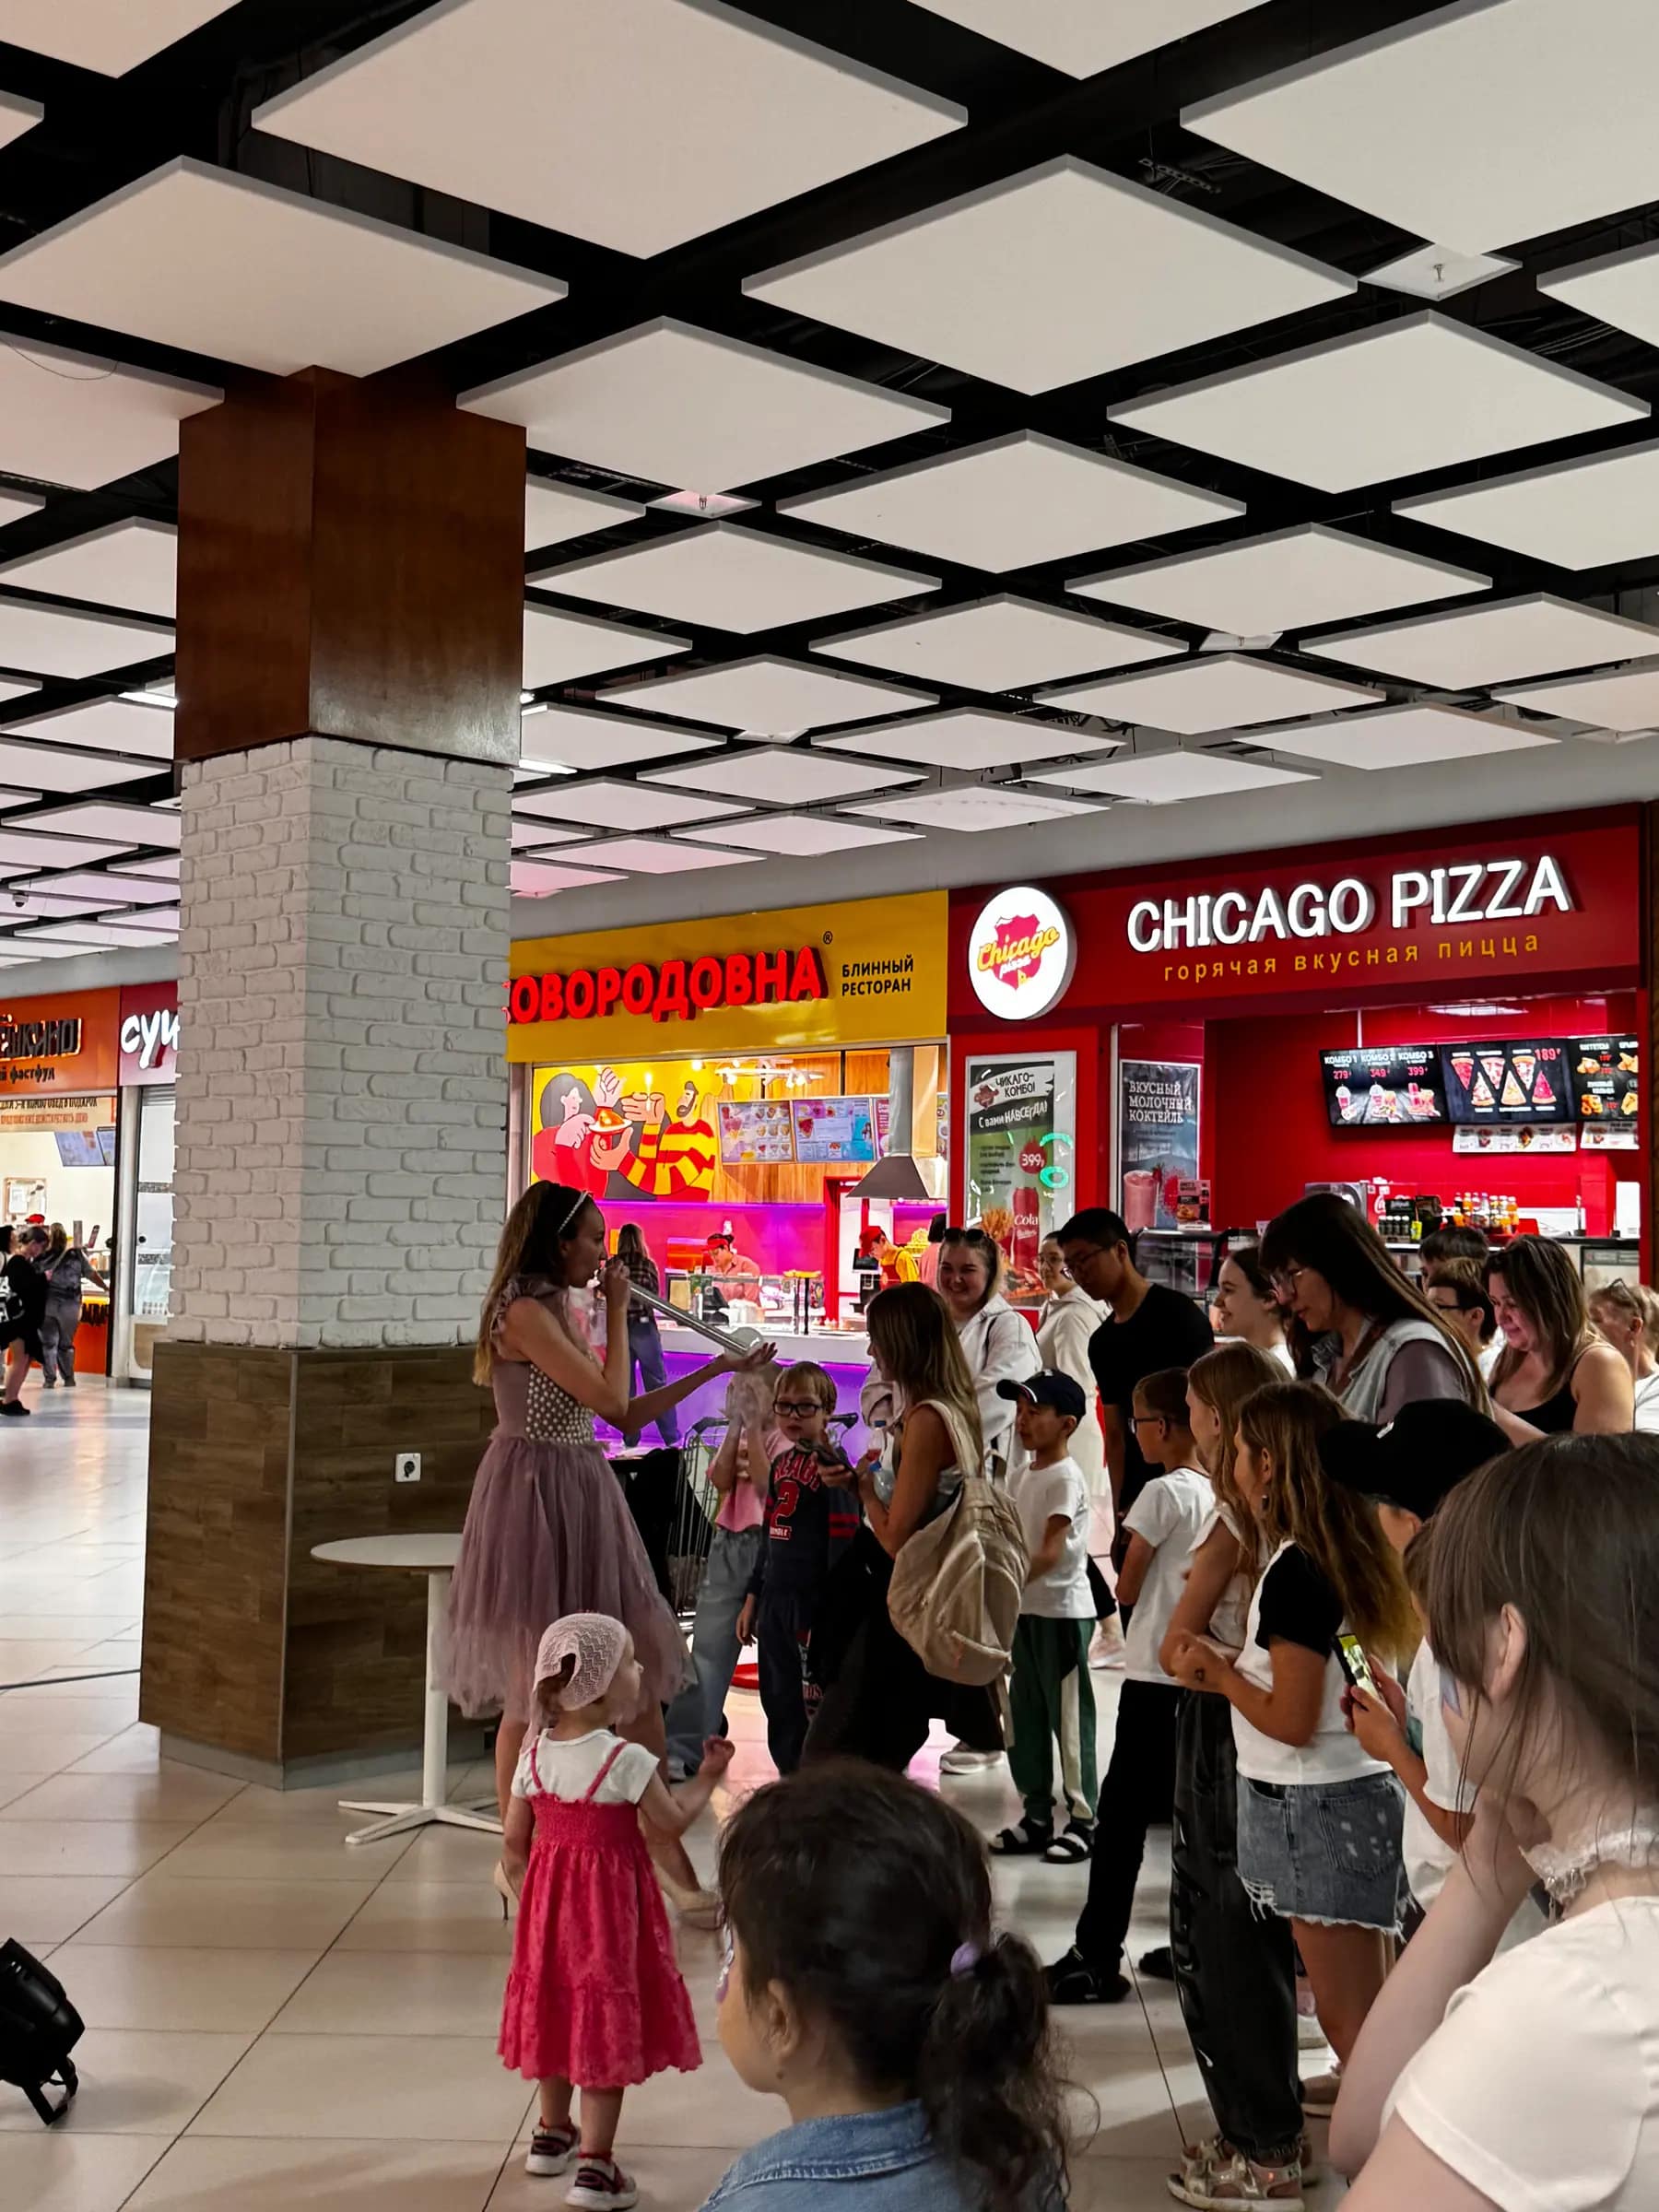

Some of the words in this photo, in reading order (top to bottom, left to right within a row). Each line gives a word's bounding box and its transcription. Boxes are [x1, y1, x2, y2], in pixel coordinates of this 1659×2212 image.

[1127, 878, 1370, 952] CHICAGO
[1392, 855, 1571, 928] PIZZA
[977, 925, 1060, 971] Chicago
[1164, 957, 1277, 983] горячая
[1294, 945, 1419, 974] вкусная
[1438, 935, 1539, 959] пицца
[841, 954, 914, 978] БЛИННЫЙ
[502, 946, 826, 1024] ОВОРОДОВНА
[841, 978, 912, 996] РЕСТОРАН
[1129, 1080, 1182, 1096] ВКУСНЫЙ
[1129, 1095, 1192, 1111] МОЛОЧНЫЙ
[1129, 1109, 1184, 1124] КОКТЕЙЛЬ
